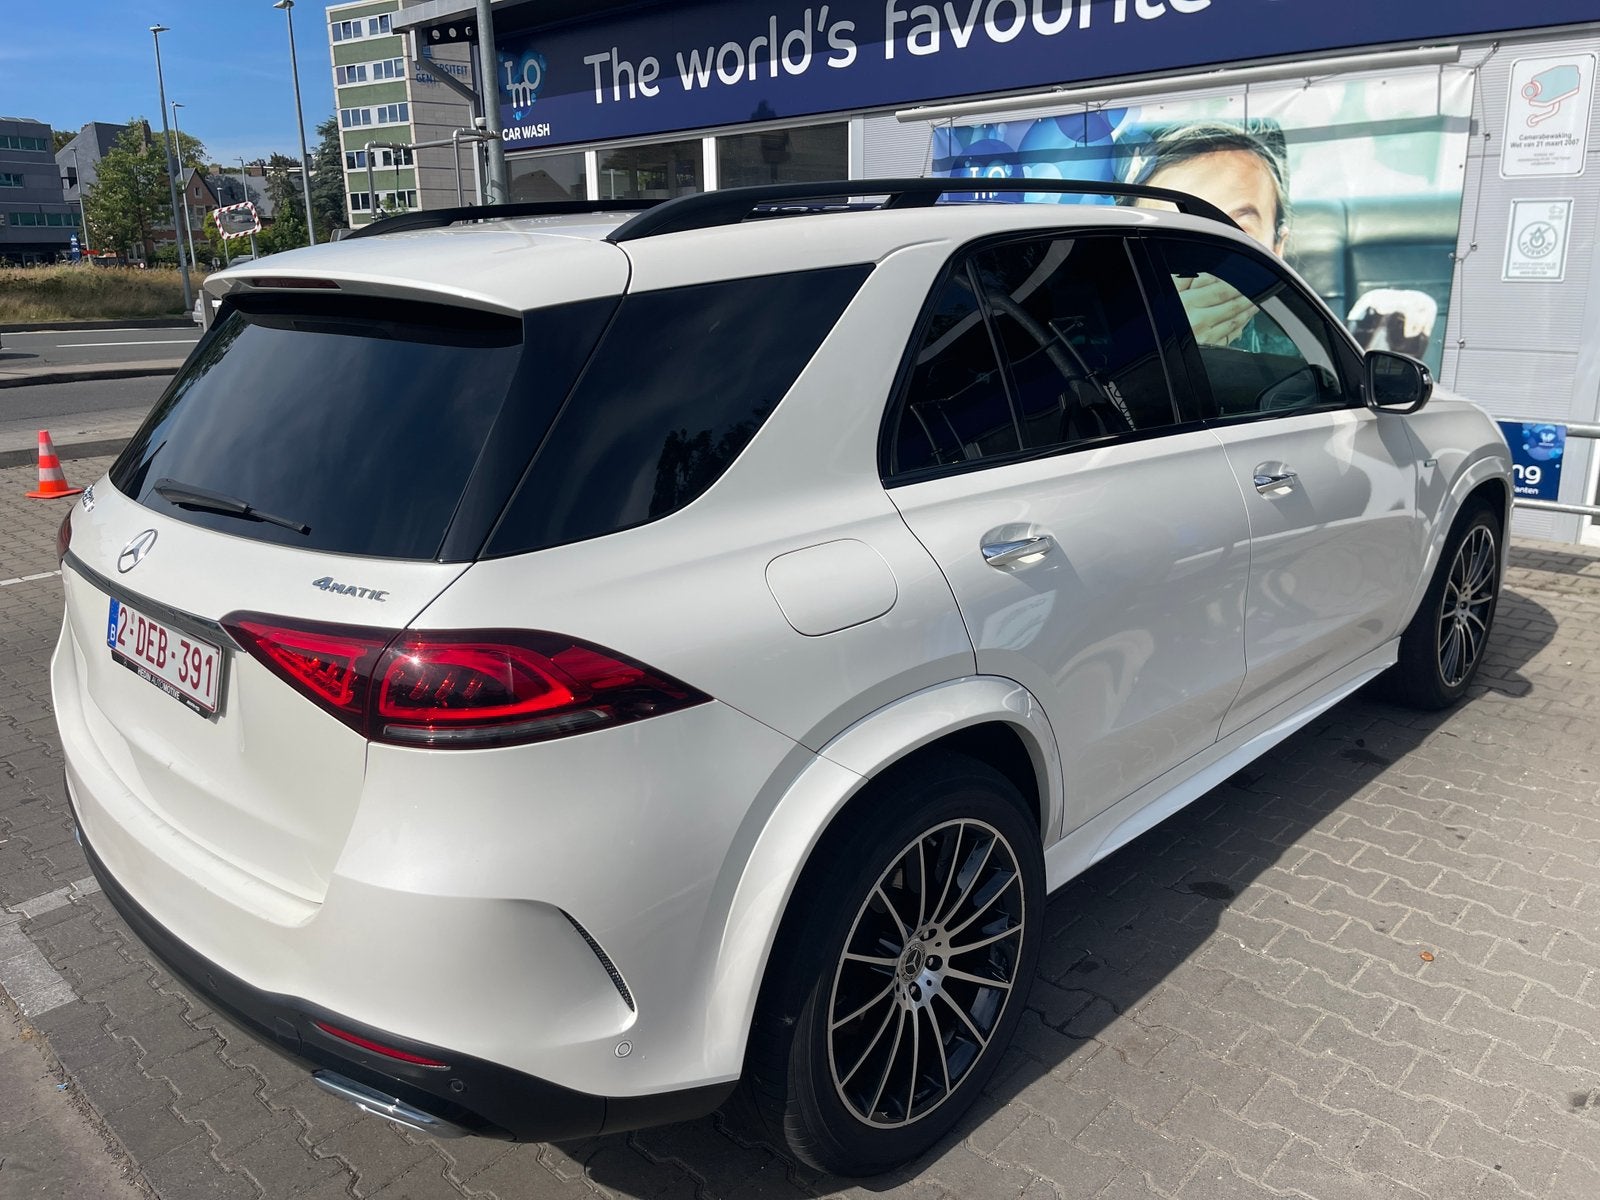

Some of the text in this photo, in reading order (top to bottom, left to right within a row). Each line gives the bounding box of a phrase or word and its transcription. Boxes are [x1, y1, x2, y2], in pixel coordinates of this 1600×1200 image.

[583, 46, 660, 104] The
[676, 5, 857, 91] world's
[502, 123, 550, 141] CAR WASH
[1564, 138, 1580, 146] 2007
[311, 576, 390, 603] 4MATIC
[110, 623, 117, 641] B
[117, 606, 213, 697] 2-DEB-391
